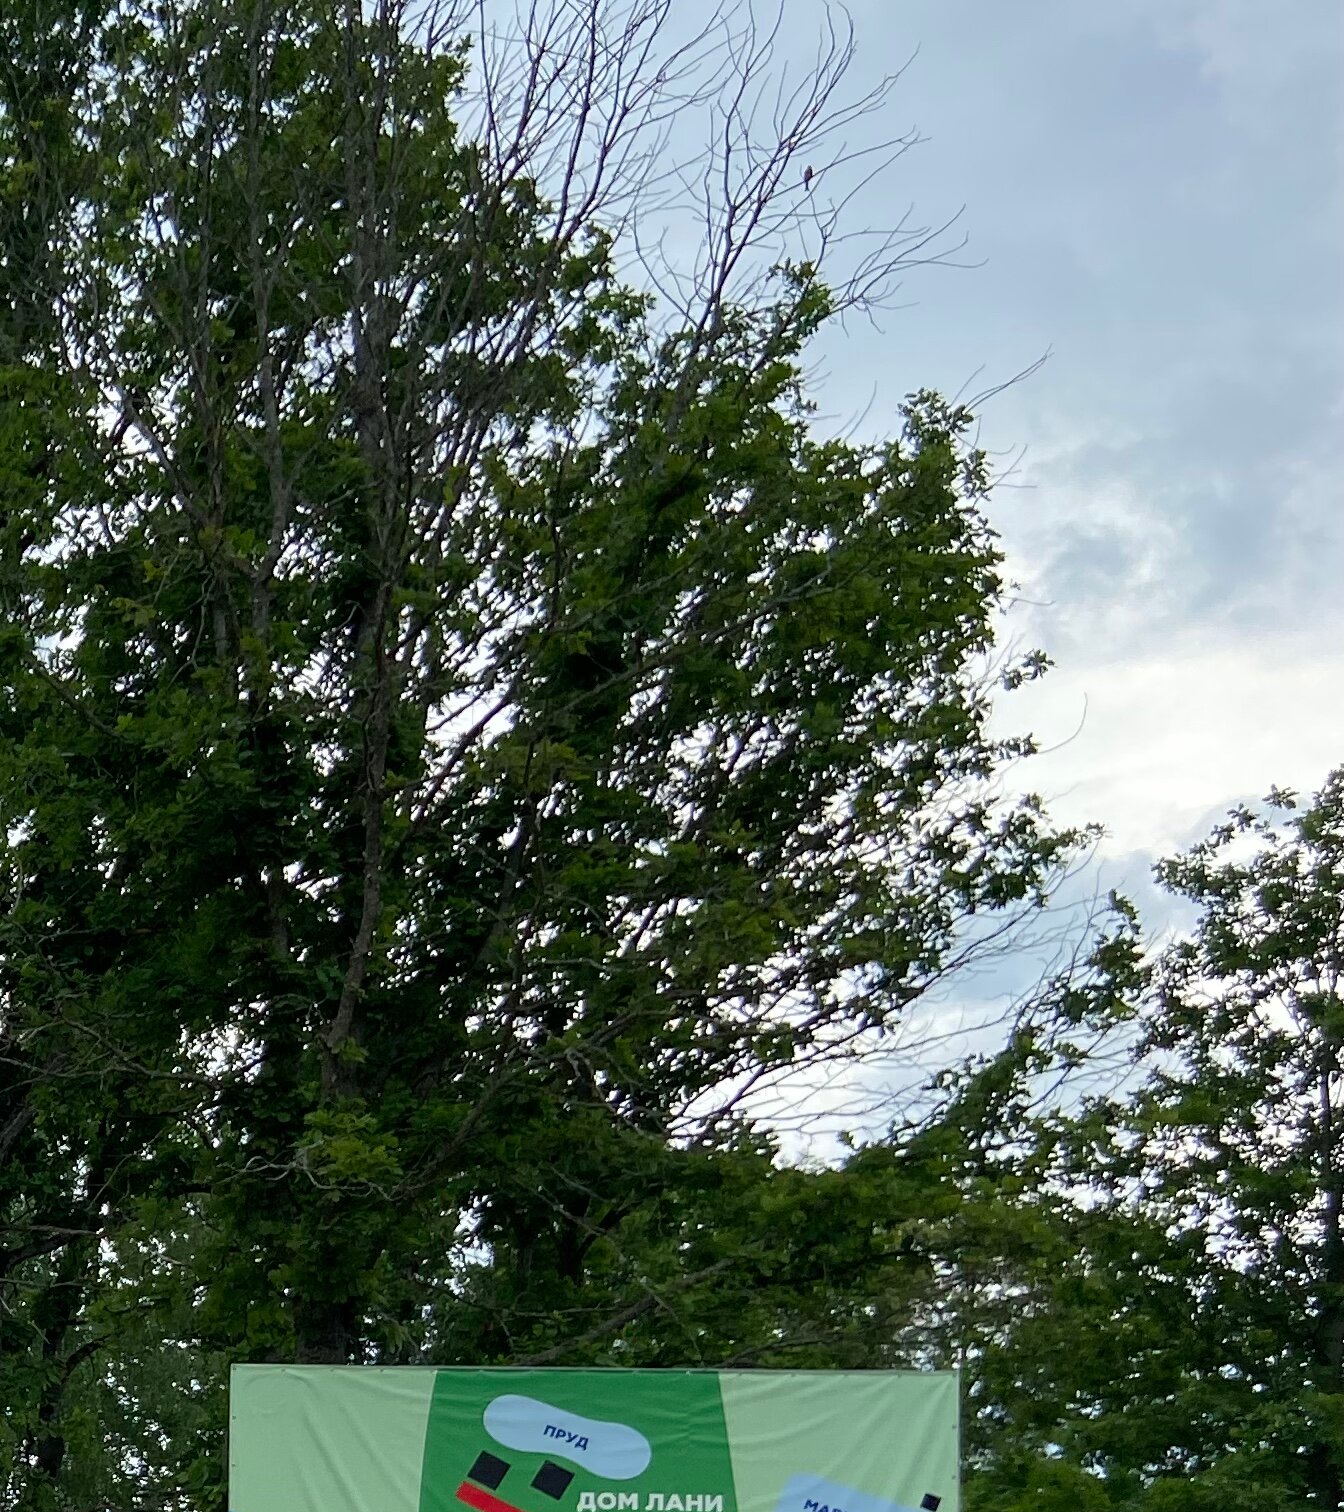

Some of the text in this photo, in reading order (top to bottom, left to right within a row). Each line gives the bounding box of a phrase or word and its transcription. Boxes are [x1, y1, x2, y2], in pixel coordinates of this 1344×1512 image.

[543, 1424, 589, 1451] ПРУД
[576, 1491, 724, 1512] ДОМ ЛАНИ
